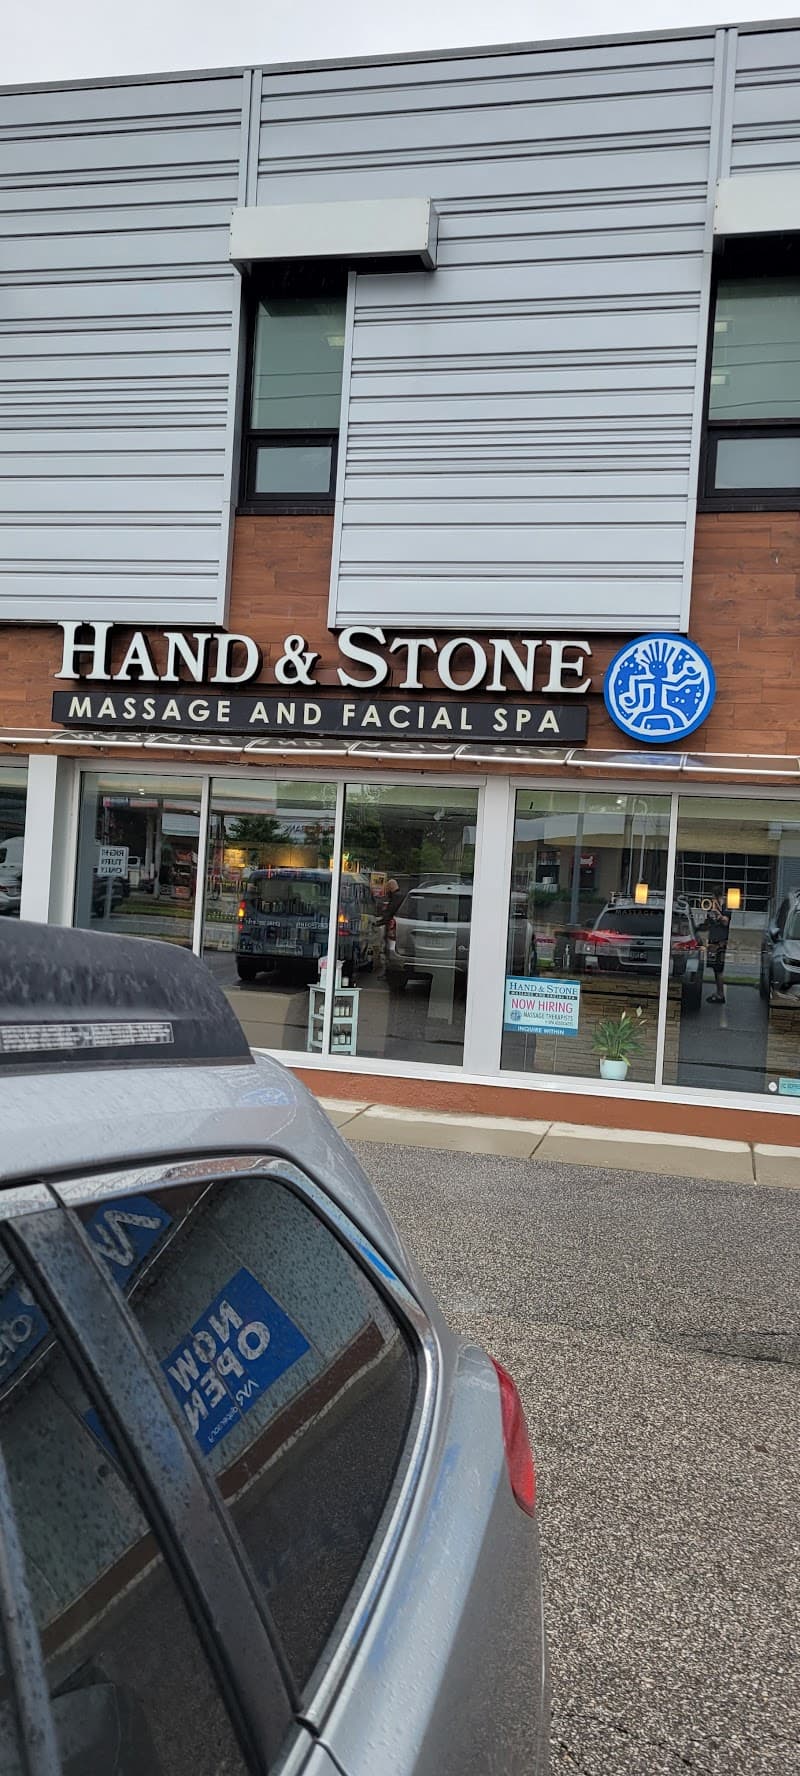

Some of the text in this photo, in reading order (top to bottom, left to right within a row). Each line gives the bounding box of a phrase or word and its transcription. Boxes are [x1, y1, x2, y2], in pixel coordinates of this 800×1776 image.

[54, 620, 593, 694] HAND & STONE
[68, 696, 561, 733] MASSAGE AND FACIAL SPA
[509, 982, 537, 992] HAND
[547, 984, 578, 995] STONE
[512, 998, 573, 1013] NOW HIRING
